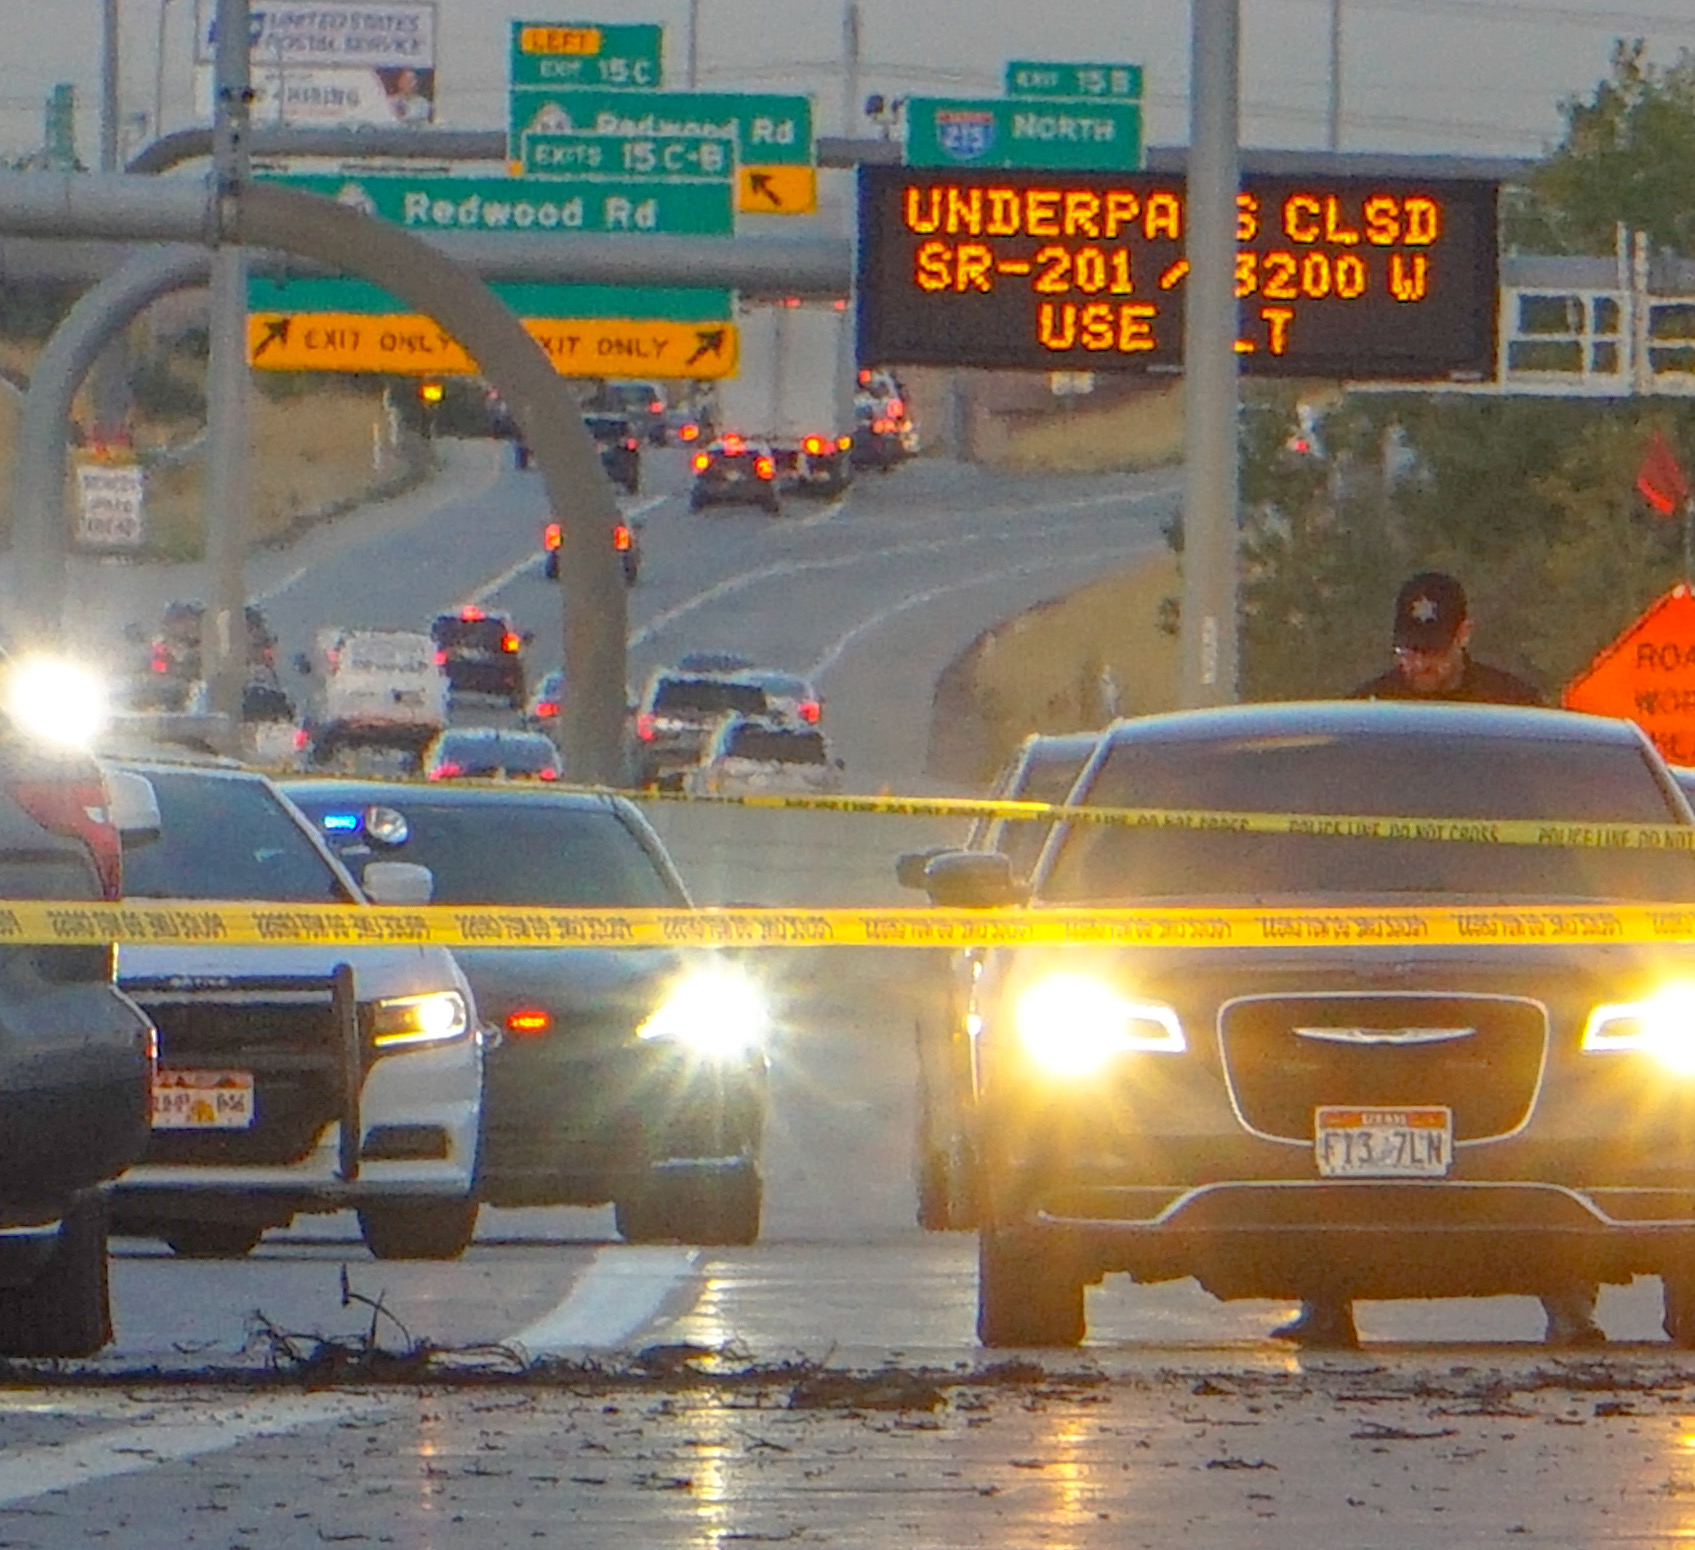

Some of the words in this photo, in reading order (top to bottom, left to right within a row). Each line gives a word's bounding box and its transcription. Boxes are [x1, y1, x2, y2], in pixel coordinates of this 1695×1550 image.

[533, 29, 588, 48] LEFT
[539, 60, 582, 77] EXIT
[751, 117, 794, 145] Rd
[1013, 112, 1115, 142] NORTH
[404, 192, 583, 228] Redwood
[606, 198, 658, 229] Rd
[905, 187, 1260, 241] UNDERPAS
[1284, 195, 1440, 245] CLSD
[915, 241, 1135, 295] SR-201
[1389, 253, 1428, 302] W
[304, 330, 361, 351] EXIT
[380, 332, 453, 354] ONLY
[1038, 302, 1158, 353] USE
[538, 336, 581, 357] XIT
[597, 338, 669, 359] ONLY
[1538, 827, 1594, 846] POLICE
[1639, 830, 1660, 848] DO
[1393, 1130, 1443, 1165] 7LN
